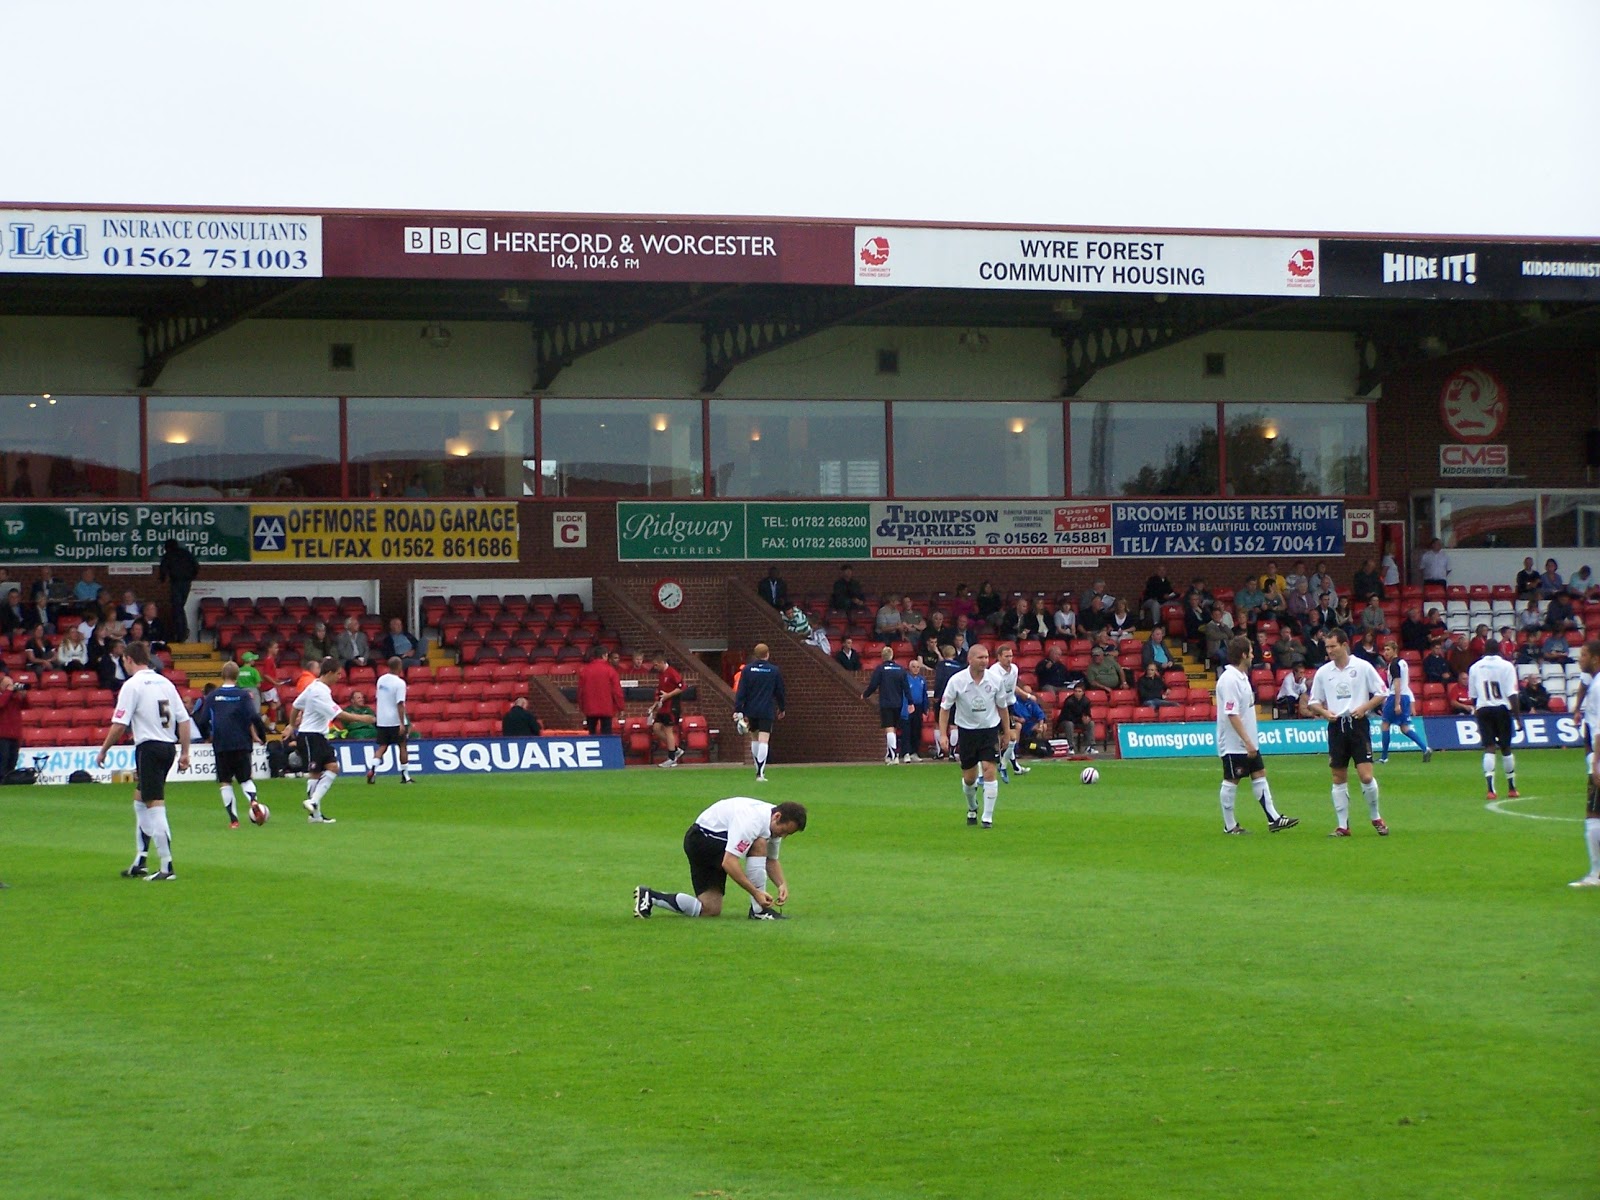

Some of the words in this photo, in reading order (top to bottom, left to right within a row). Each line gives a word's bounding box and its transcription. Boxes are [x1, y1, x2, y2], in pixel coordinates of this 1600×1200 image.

[103, 219, 193, 239] INSURANCE
[198, 221, 308, 241] CONSULTANTS
[12, 224, 87, 258] Ltd
[406, 228, 486, 253] BBC
[494, 233, 613, 253] HEREFORD
[620, 235, 635, 254] &
[640, 234, 777, 256] WORCESTER
[1020, 240, 1078, 259] WYRE
[1086, 242, 1164, 261] FOREST
[103, 247, 192, 268] 01562
[203, 249, 309, 270] 751003
[550, 255, 579, 270] 104,
[582, 255, 619, 269] 104.6
[625, 258, 640, 269] FM
[1382, 252, 1438, 283] HIRE
[1442, 252, 1476, 284] IT!
[979, 262, 1105, 284] COMMUNITY
[1112, 265, 1205, 286] HOUSING
[1441, 446, 1507, 466] CMS
[1442, 467, 1506, 475] KIDDERMINSTER
[65, 507, 130, 525] Travis
[136, 507, 216, 525] Perkins
[288, 509, 377, 533] OFFMORE
[384, 509, 435, 532] ROAD
[440, 508, 515, 533] GARAGE
[762, 516, 788, 527] TEL:
[792, 516, 825, 527] 01782
[828, 516, 867, 527] 268200
[886, 505, 998, 523] THOMPSON
[1116, 506, 1187, 521] BROOME
[1192, 506, 1245, 520] HOUSE
[1250, 506, 1288, 520] REST
[1292, 506, 1338, 520] HOME
[73, 529, 125, 541] Timber
[130, 529, 142, 542] &
[146, 528, 209, 544] Building
[560, 524, 580, 544] C
[622, 512, 733, 542] Ridgway
[1138, 523, 1183, 532] SITUATED
[1186, 523, 1196, 532] IN
[1200, 522, 1250, 532] BEAUTIFUL
[1253, 522, 1316, 532] COUNTRYSIDE
[1351, 522, 1368, 539] D
[291, 538, 372, 558] TEL/FAX
[381, 538, 434, 558] 01562
[442, 538, 512, 557] 861686
[762, 538, 788, 548] FAX:
[792, 538, 825, 548] 01782
[828, 538, 868, 548] 268300
[1004, 532, 1048, 544] 01562
[1054, 532, 1107, 544] 745881
[1120, 537, 1158, 553] TEL/
[1165, 536, 1205, 552] FAX:
[1211, 536, 1266, 552] 01562
[1272, 536, 1336, 551] 700417
[55, 544, 128, 560] Suppliers
[132, 544, 154, 556] for
[186, 543, 228, 556] Trade
[654, 546, 722, 554] CATERERS
[876, 548, 924, 556] BUILDERS,
[926, 548, 974, 556] PLUMBERS
[1484, 680, 1502, 700] 10
[158, 700, 170, 728] 5
[1128, 731, 1214, 752] Bromsgrove
[1286, 728, 1328, 746] Floori
[333, 745, 422, 774] LUE
[434, 741, 603, 772] SQUARE
